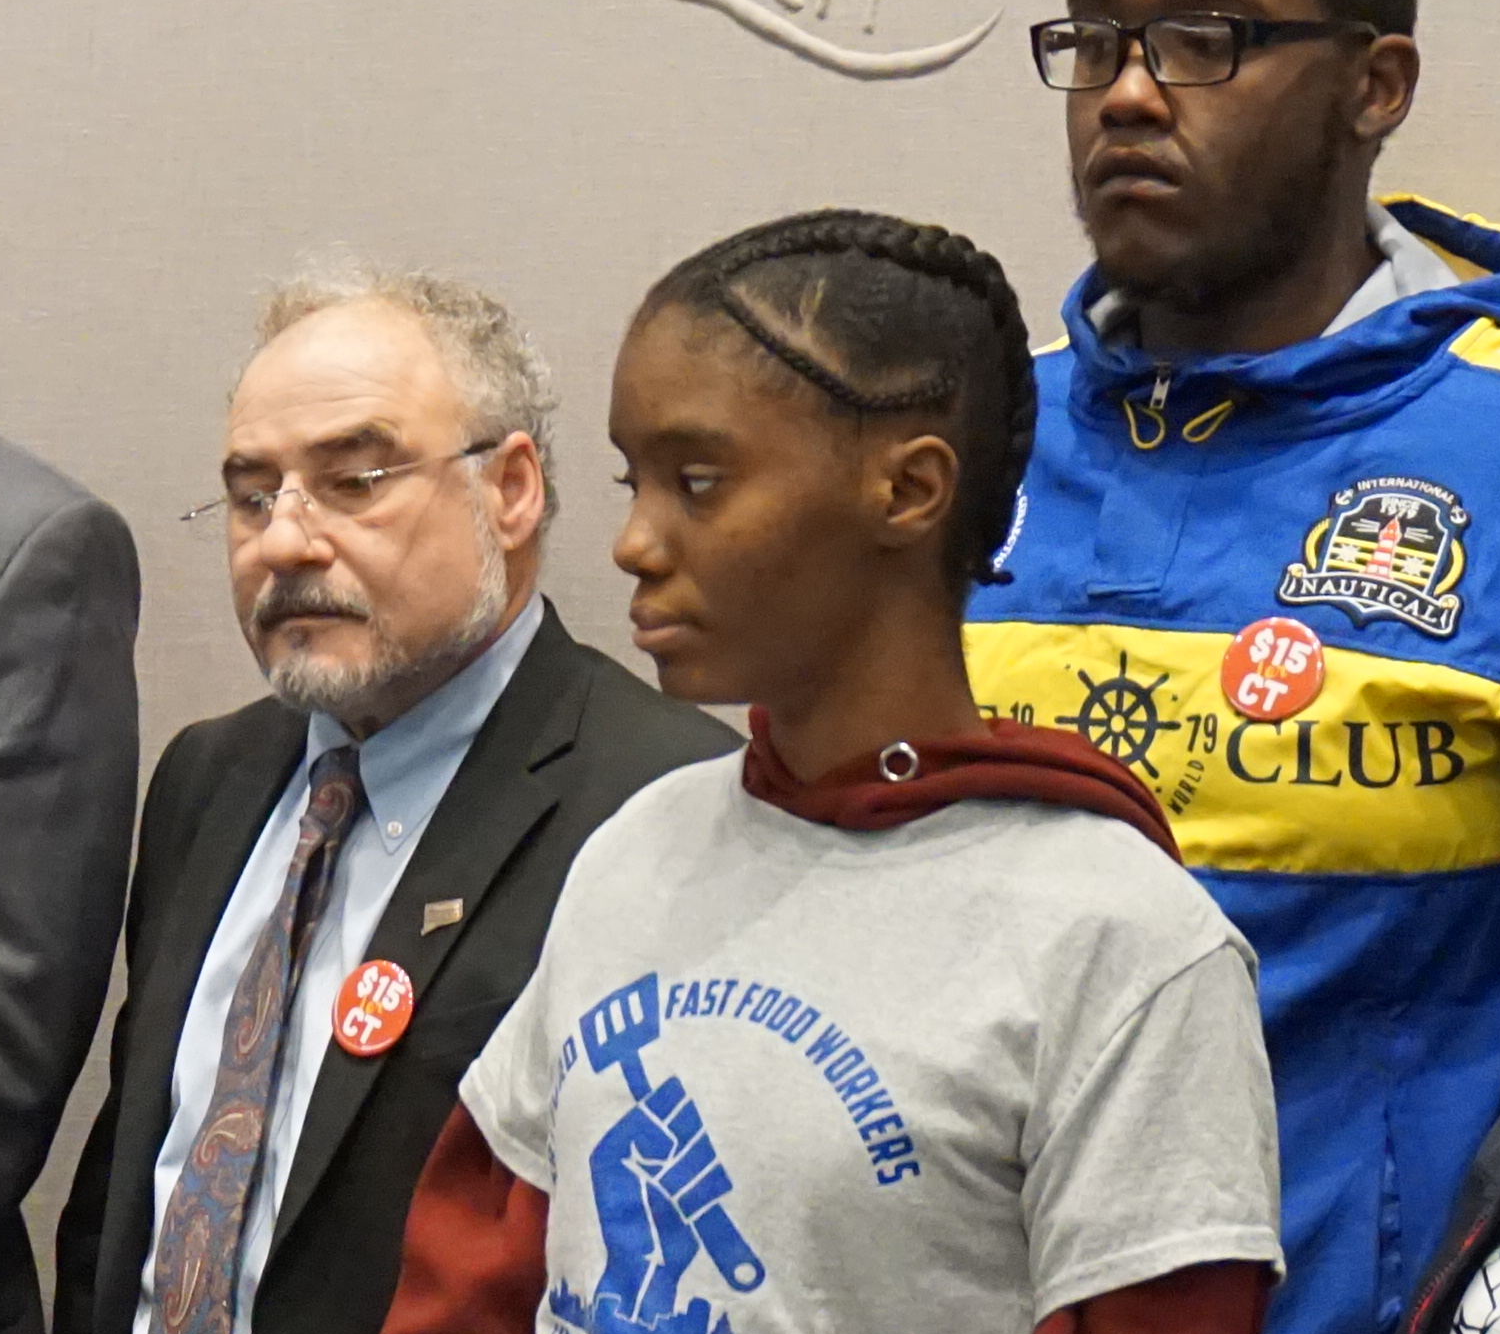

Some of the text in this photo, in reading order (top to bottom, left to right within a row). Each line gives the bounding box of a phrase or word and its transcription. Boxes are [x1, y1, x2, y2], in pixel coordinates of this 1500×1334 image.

[1357, 477, 1455, 505] INTERNATIONAL
[1380, 497, 1421, 512] SINCE
[1300, 578, 1438, 624] NAUTICAL
[1249, 628, 1313, 675] $15
[1237, 672, 1289, 712] CT
[1186, 713, 1218, 755] 79
[1225, 717, 1466, 788] CLUB
[1167, 759, 1205, 816] WORLD
[357, 965, 406, 1011] $15
[342, 1006, 383, 1044] CT
[665, 979, 921, 1187] FAST FOOD WORKERS
